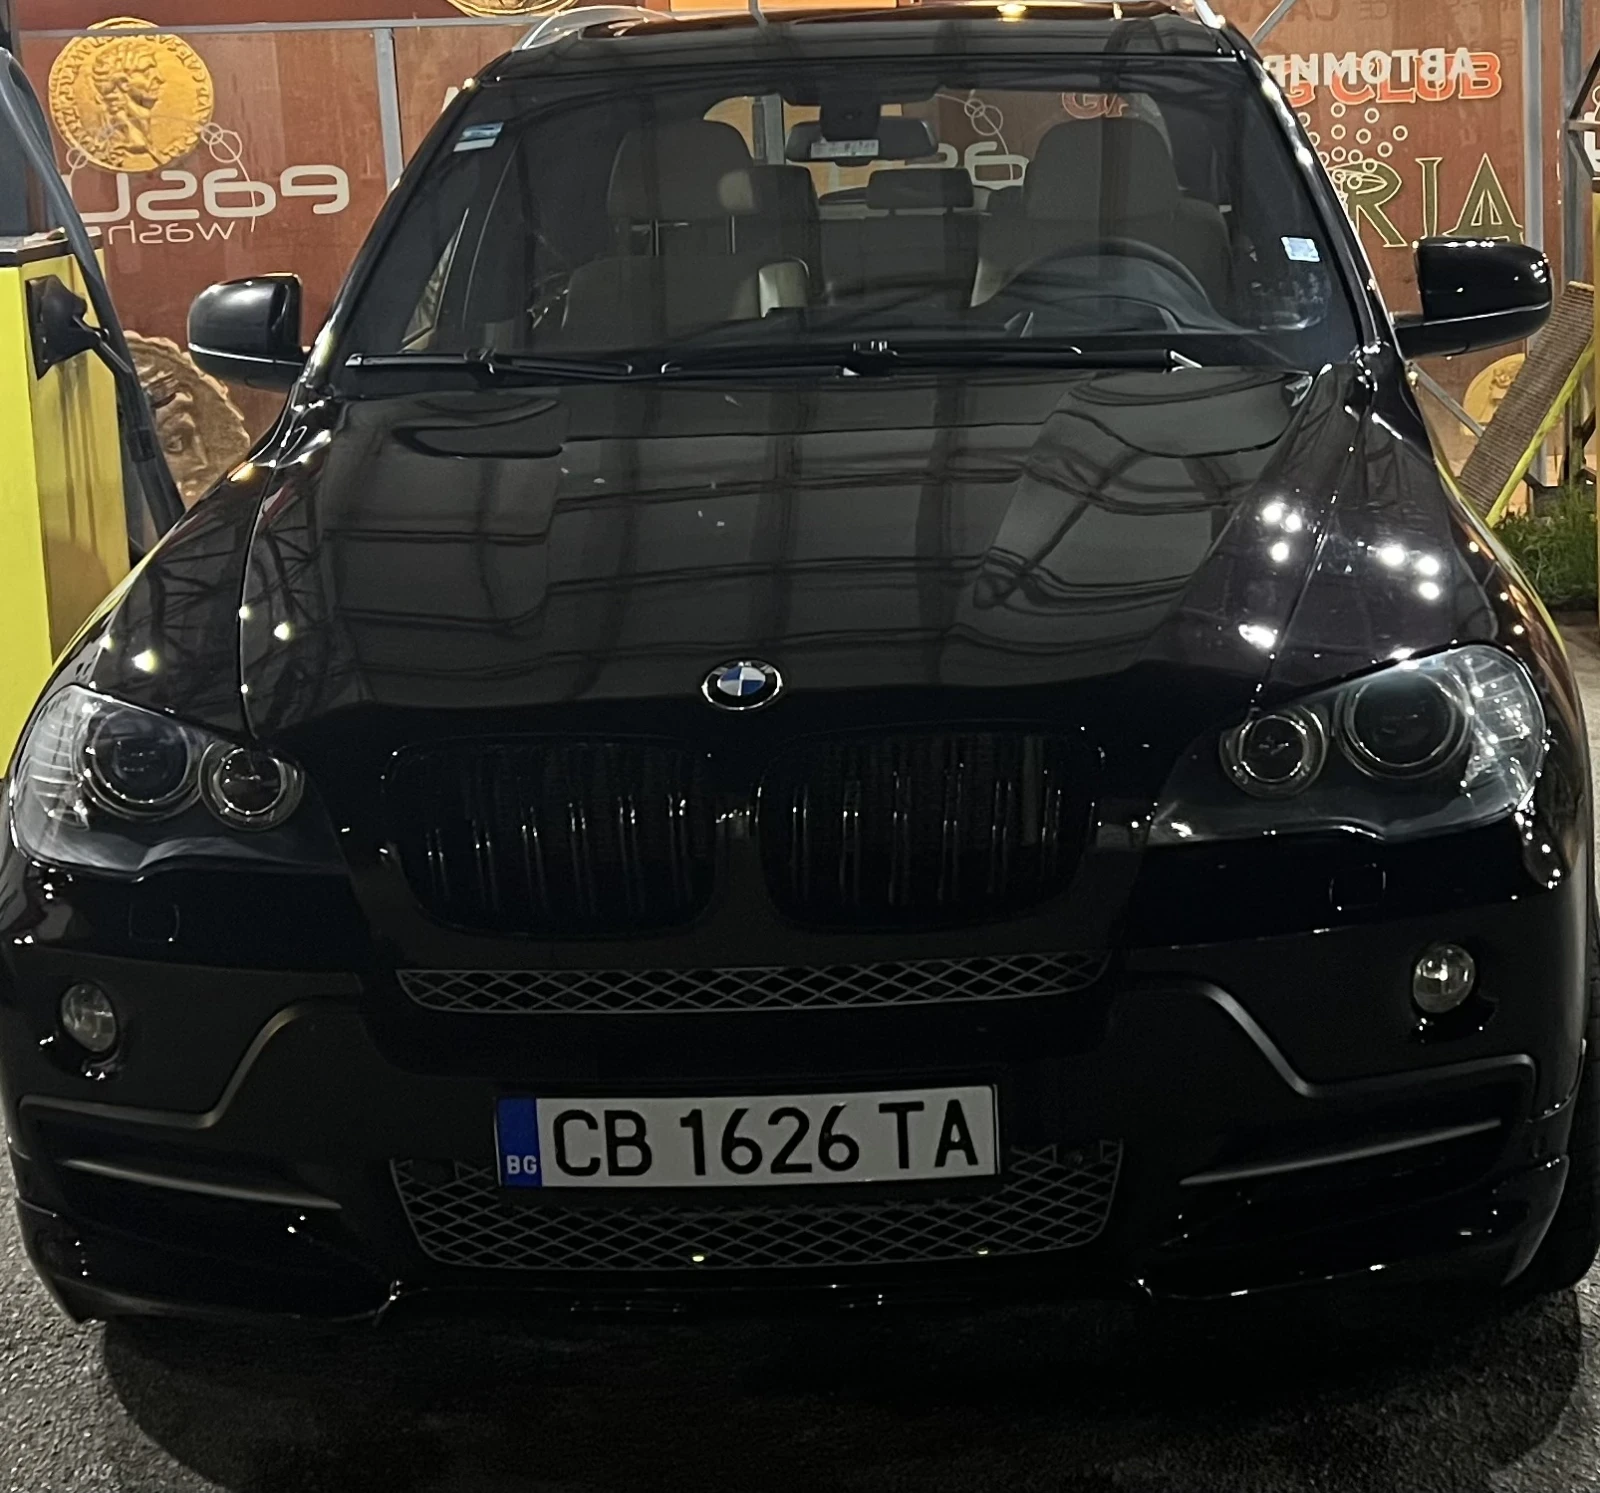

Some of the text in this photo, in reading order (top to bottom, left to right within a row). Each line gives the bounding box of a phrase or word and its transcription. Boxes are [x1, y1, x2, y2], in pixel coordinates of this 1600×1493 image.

[553, 1099, 979, 1176] CB 1626 TA
[506, 1154, 537, 1175] BG
